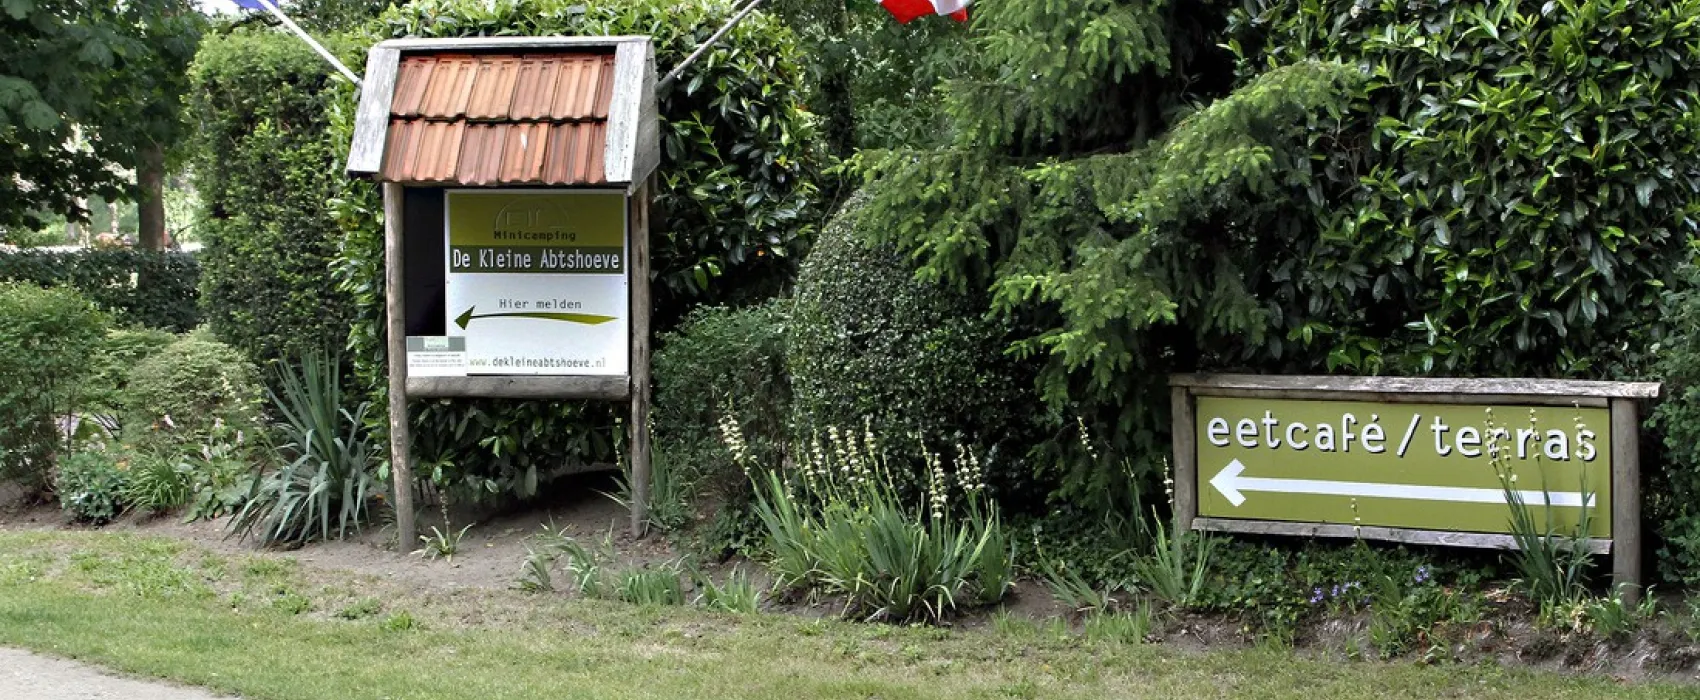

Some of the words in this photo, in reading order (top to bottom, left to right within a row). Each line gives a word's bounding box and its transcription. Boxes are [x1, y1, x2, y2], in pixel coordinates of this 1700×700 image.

[494, 230, 576, 241] Minicamping
[453, 249, 471, 268] De
[479, 249, 531, 269] Kleine
[540, 249, 620, 269] Abtshoeve
[499, 299, 529, 309] Hier
[536, 299, 582, 309] melden
[469, 355, 606, 368] www.dekleineabtshoeve.nl
